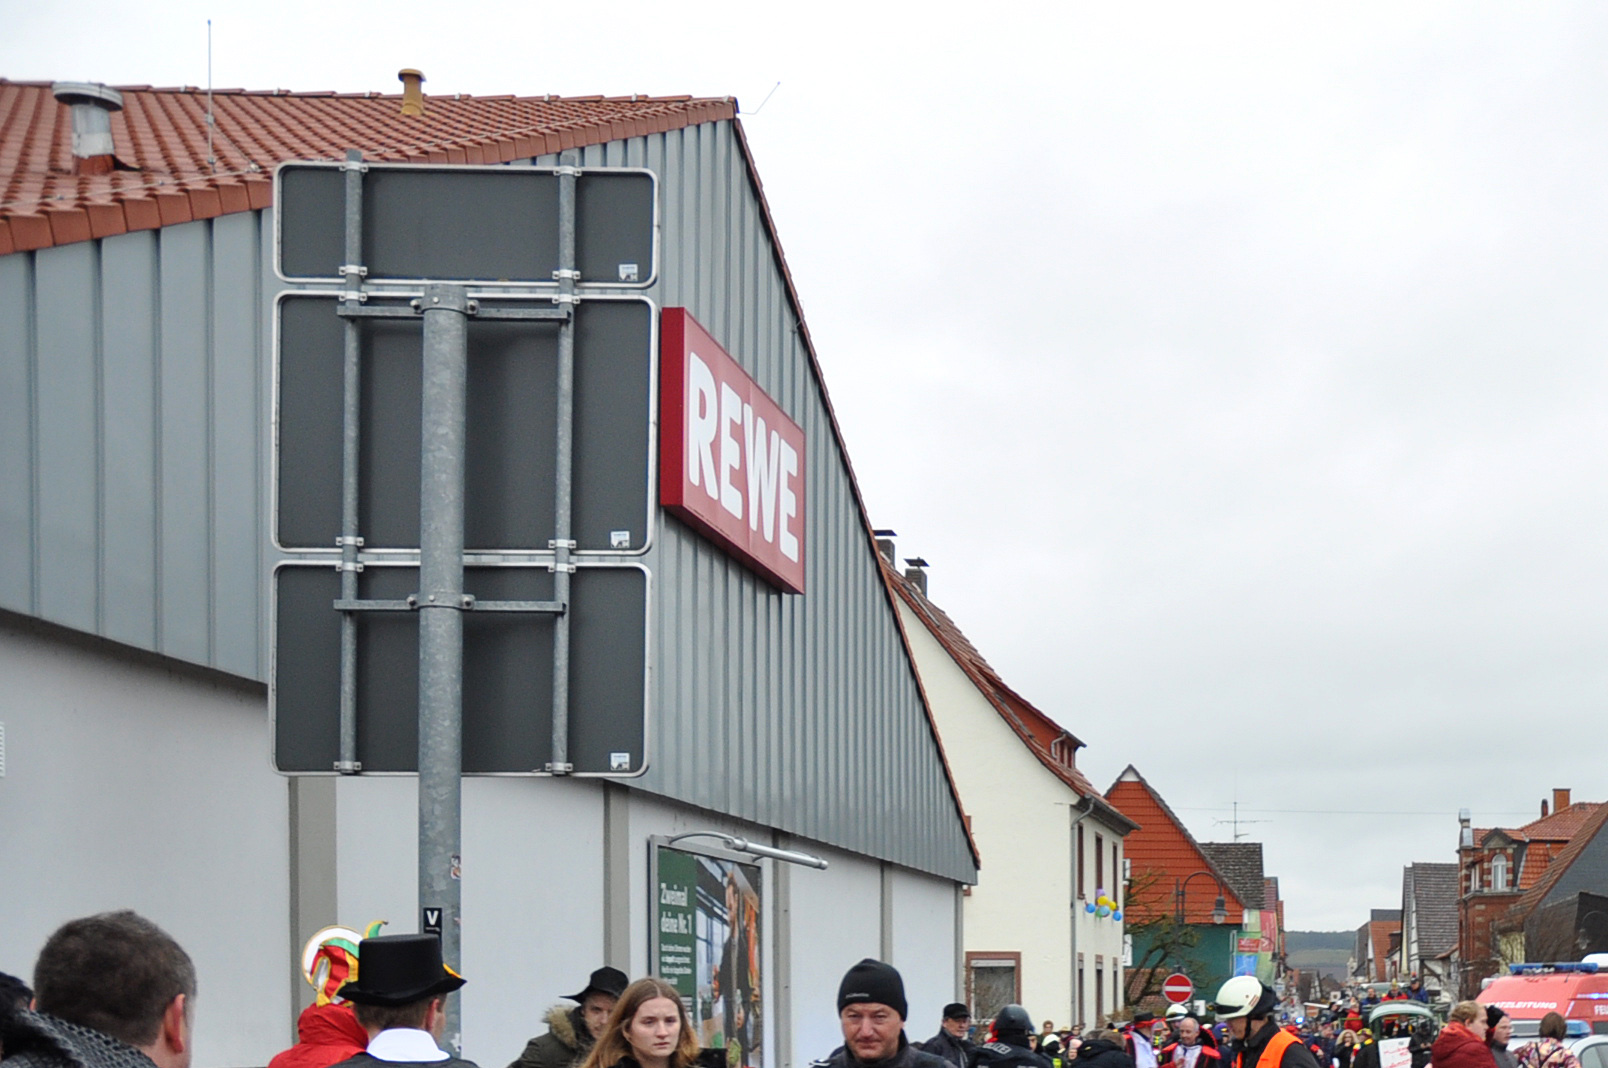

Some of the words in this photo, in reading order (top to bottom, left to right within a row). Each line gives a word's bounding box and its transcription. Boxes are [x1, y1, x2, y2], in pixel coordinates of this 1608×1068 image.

[689, 352, 799, 564] REWE
[661, 883, 688, 907] Zweimal
[426, 910, 439, 926] V
[661, 911, 678, 933] deine
